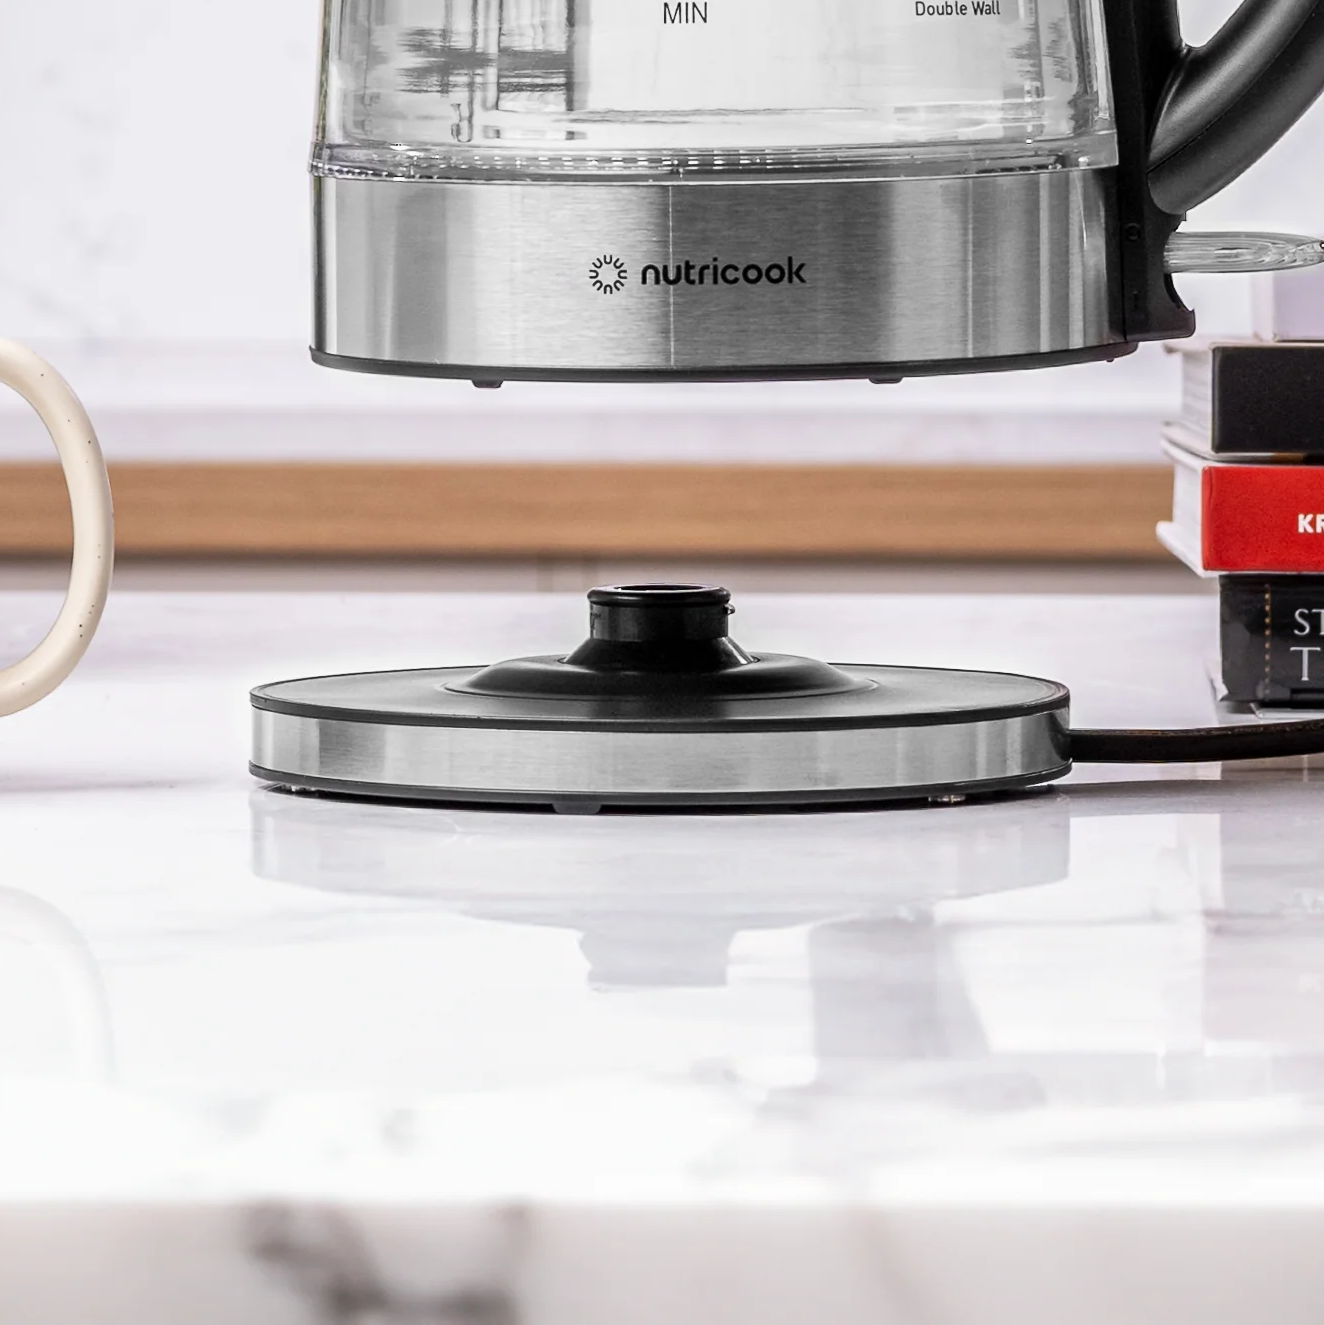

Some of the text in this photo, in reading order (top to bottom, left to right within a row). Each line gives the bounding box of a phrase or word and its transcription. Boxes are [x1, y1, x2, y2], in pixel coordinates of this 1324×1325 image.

[663, 1, 708, 24] MIN
[915, 0, 1001, 16] Double Wall
[641, 256, 807, 286] nutricook
